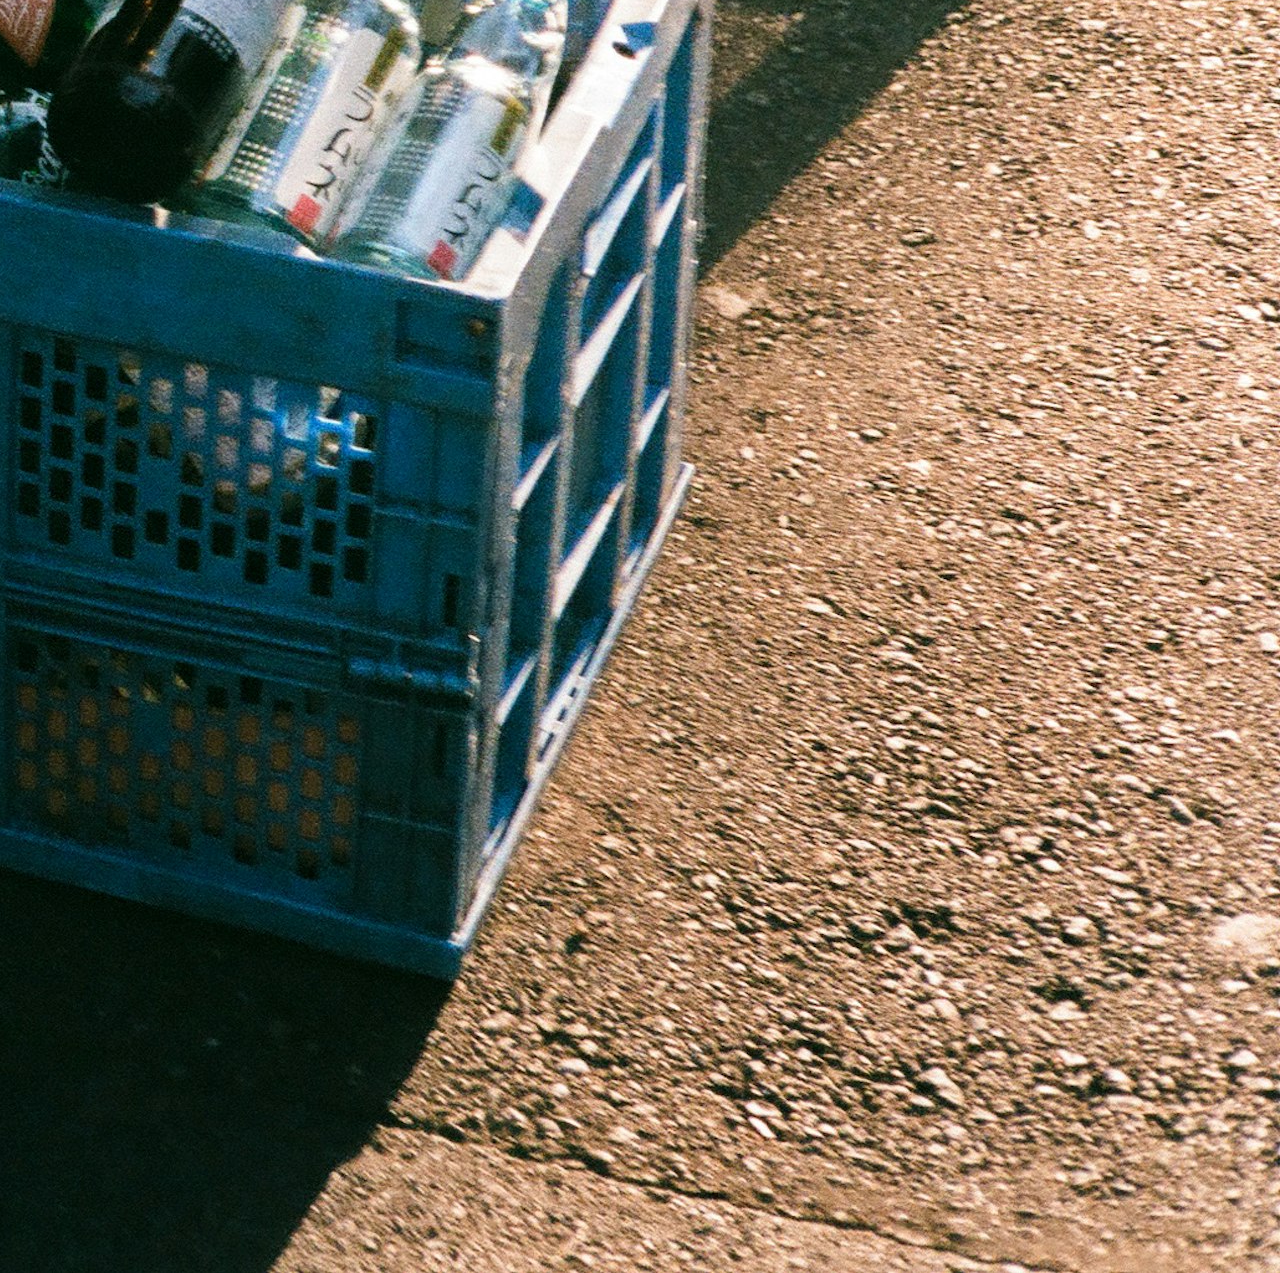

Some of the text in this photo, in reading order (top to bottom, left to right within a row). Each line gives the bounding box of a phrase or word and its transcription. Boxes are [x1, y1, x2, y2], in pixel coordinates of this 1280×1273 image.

[306, 85, 377, 200] ラムネ
[442, 146, 508, 250] ラムネ
